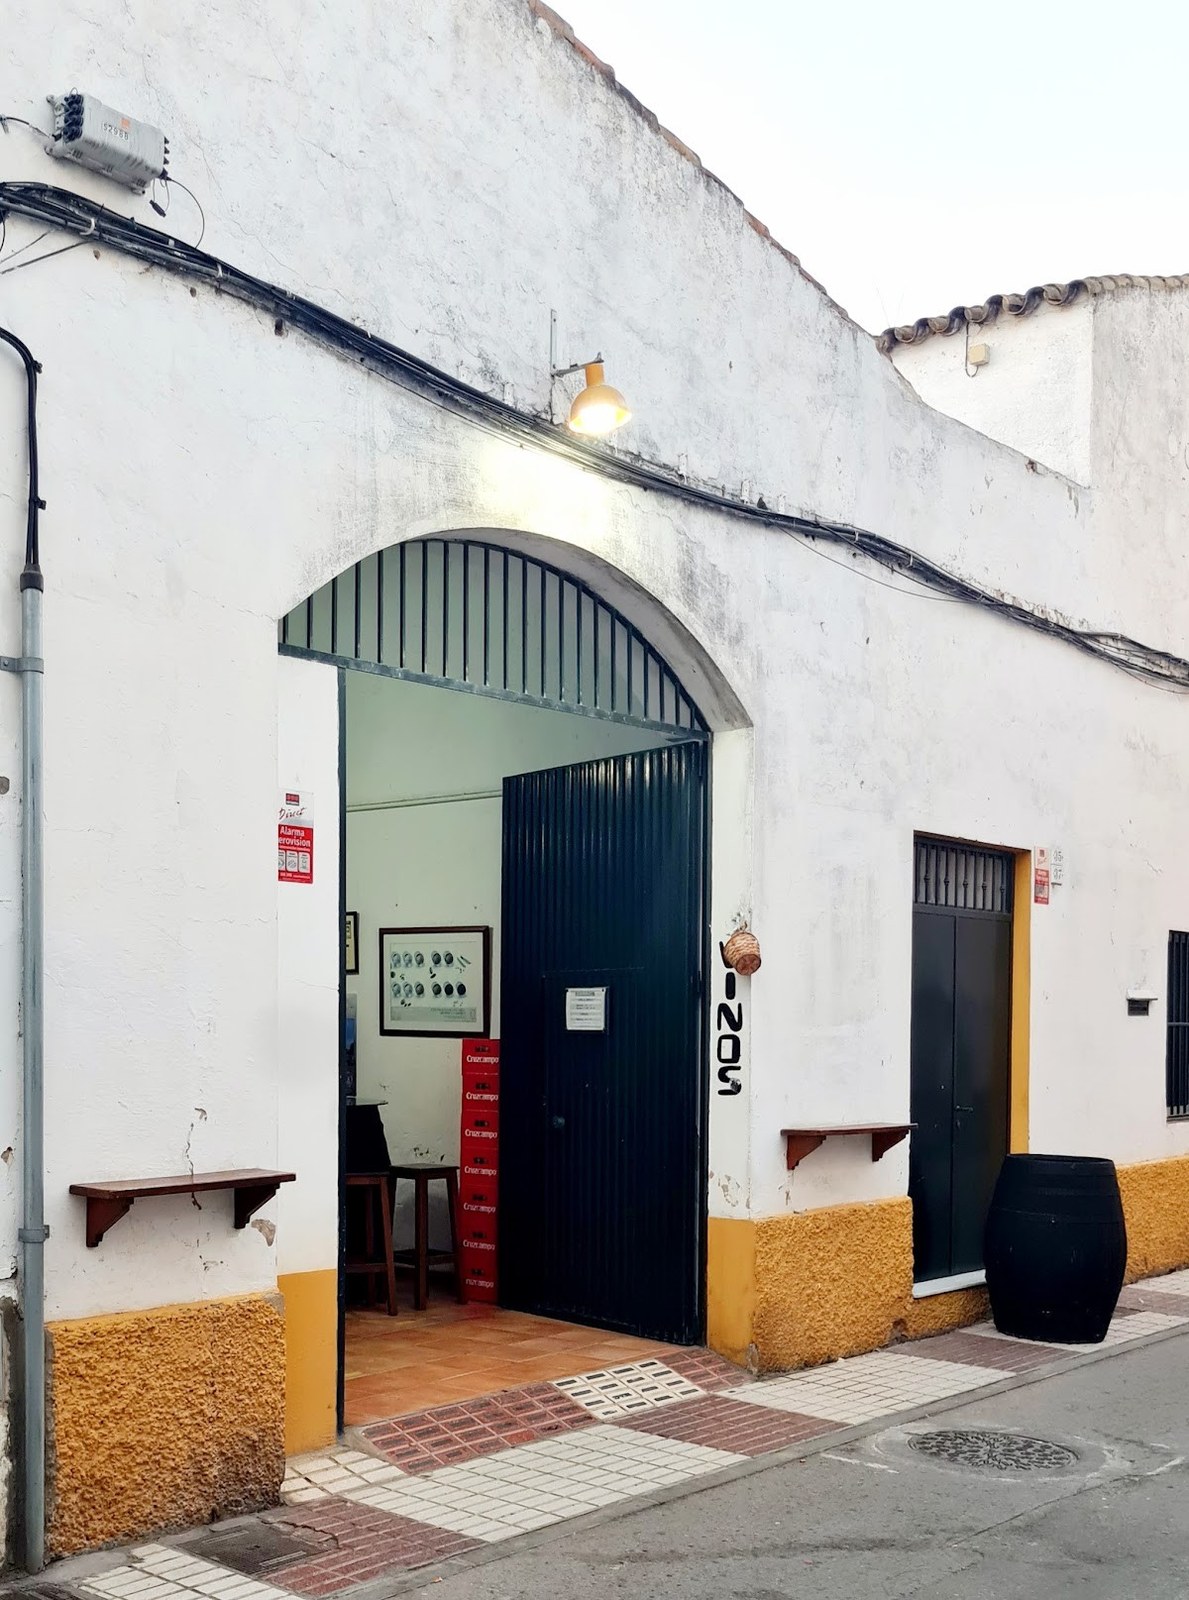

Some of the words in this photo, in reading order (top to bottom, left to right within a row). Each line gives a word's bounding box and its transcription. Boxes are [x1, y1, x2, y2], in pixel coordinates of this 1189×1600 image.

[280, 825, 305, 837] Alarma
[278, 836, 311, 847] erovision
[466, 1055, 499, 1064] Cruzcampo
[466, 1092, 499, 1102] Cruzcampo
[464, 1129, 498, 1139] Cruzcampo
[464, 1166, 497, 1176] Cruzcampo
[463, 1203, 496, 1214] Cruzcampo
[462, 1239, 496, 1251] Cruzcampo
[465, 1278, 494, 1288] ruzcampo
